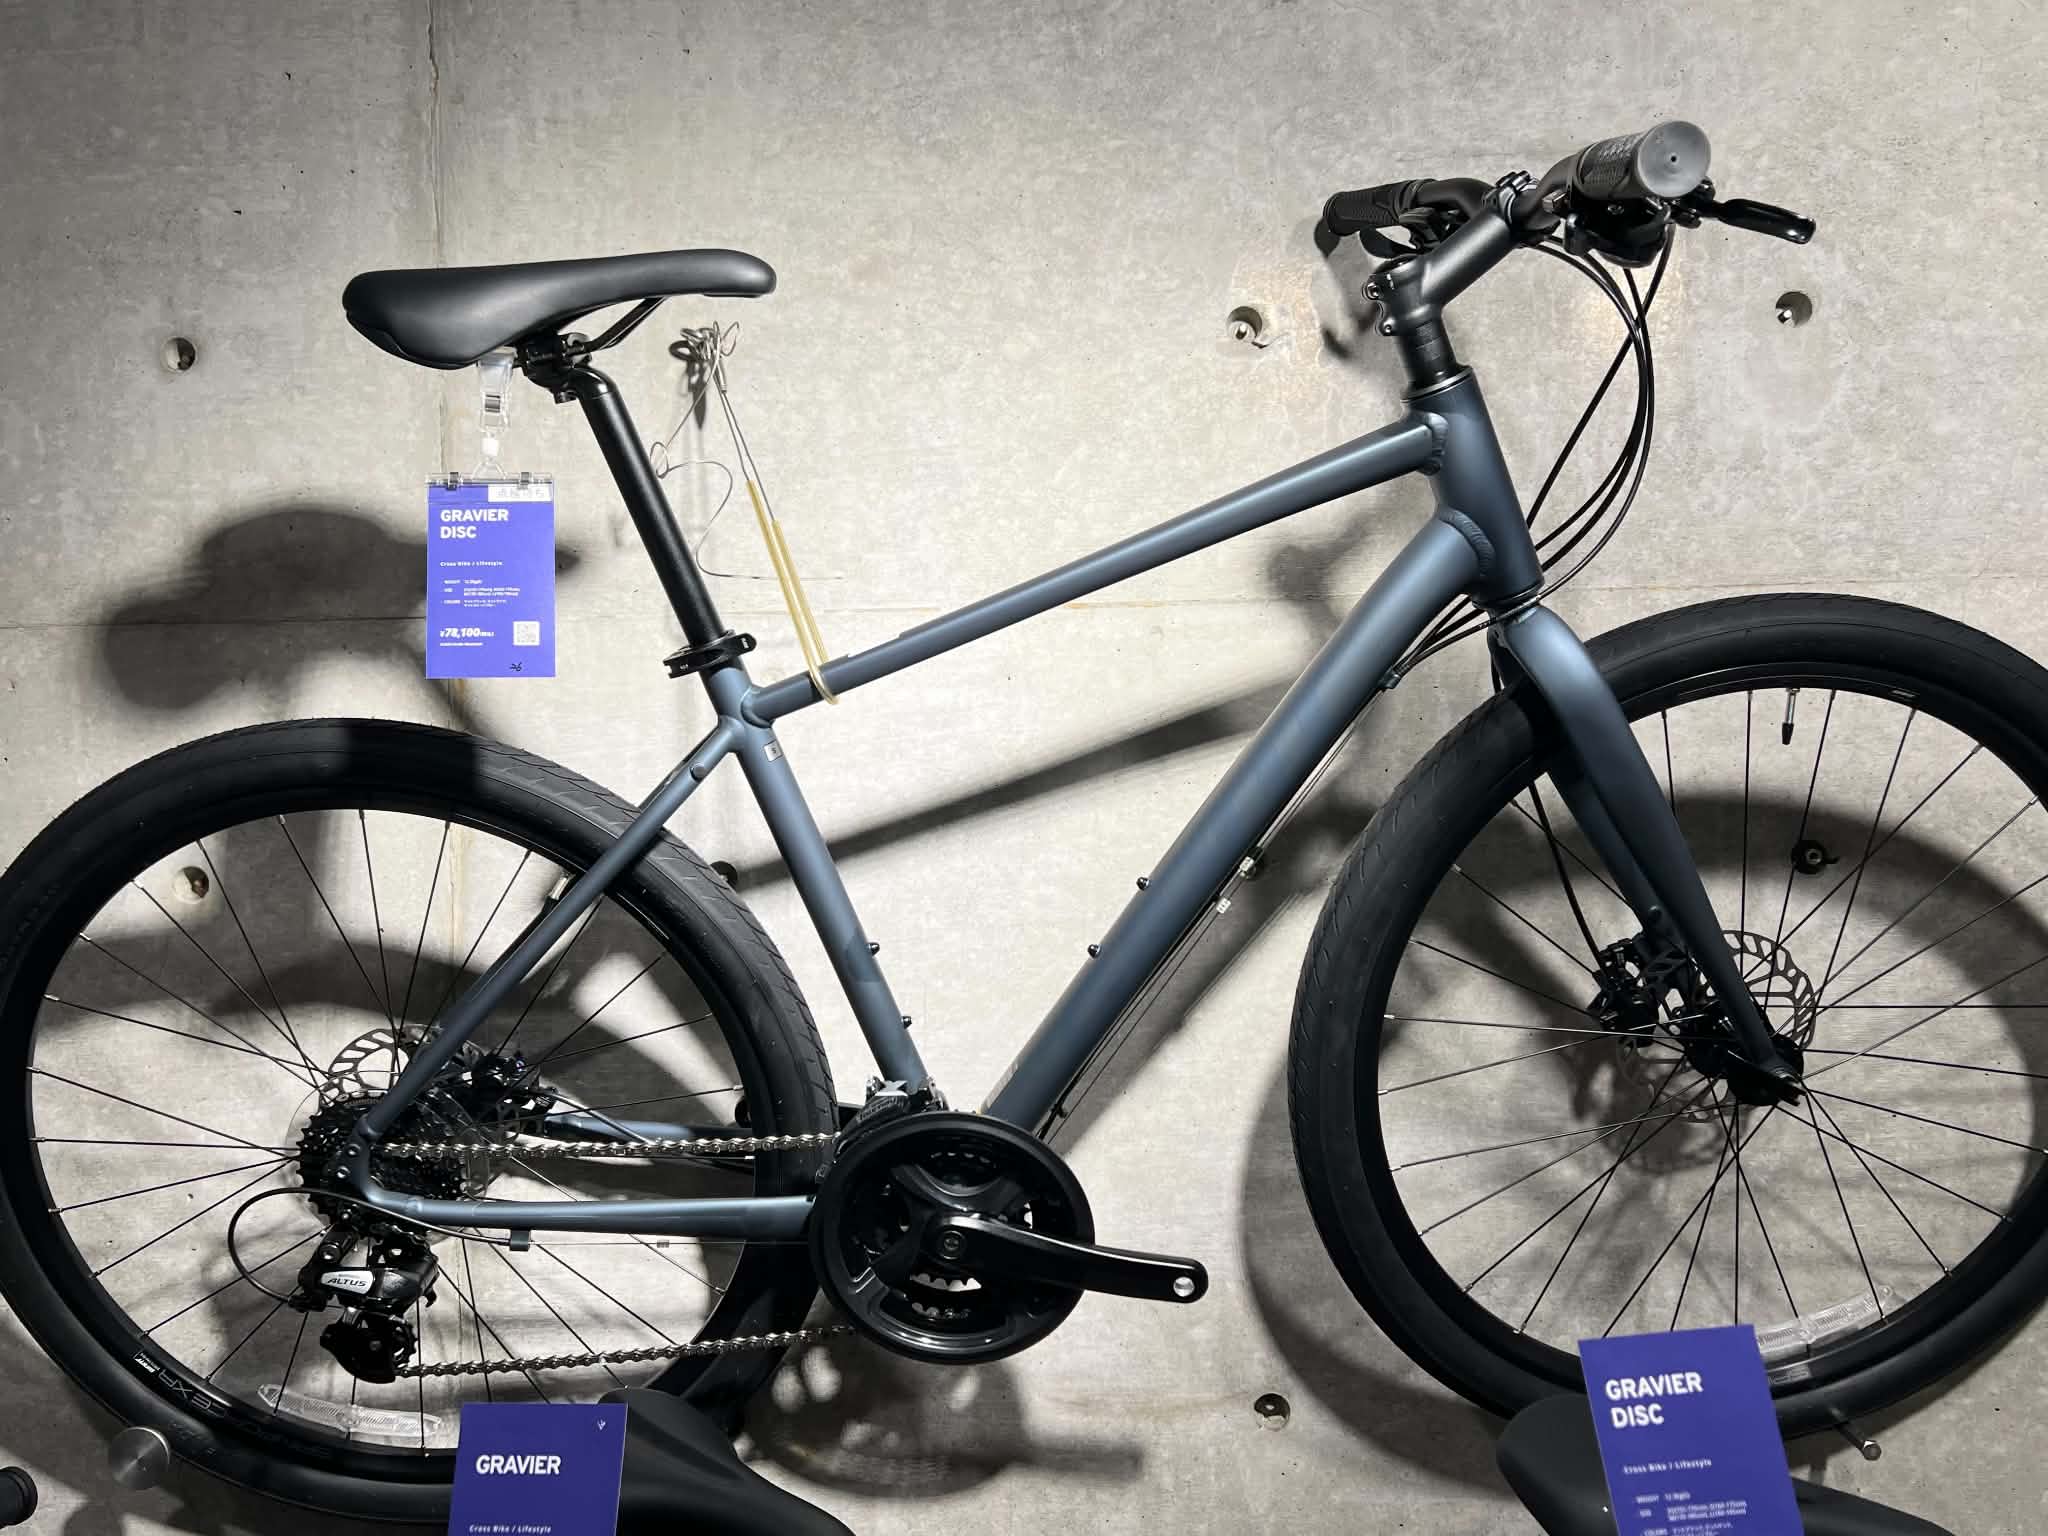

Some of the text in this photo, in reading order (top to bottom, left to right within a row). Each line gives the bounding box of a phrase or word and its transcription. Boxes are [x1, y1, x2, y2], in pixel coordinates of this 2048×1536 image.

[440, 509, 509, 522] GRAVIER
[440, 526, 477, 539] DISC
[327, 1277, 367, 1287] ALTUS
[1605, 1372, 1703, 1401] GRAVIER
[1611, 1403, 1665, 1429] DISC
[476, 1454, 562, 1475] GRAVIER
[1623, 1465, 1647, 1475] Cross
[1648, 1463, 1667, 1471] Bike
[1674, 1458, 1712, 1470] Lifestyle
[469, 1524, 491, 1533] Cross
[493, 1524, 510, 1533] Bike
[517, 1524, 552, 1535] Lifestyle
